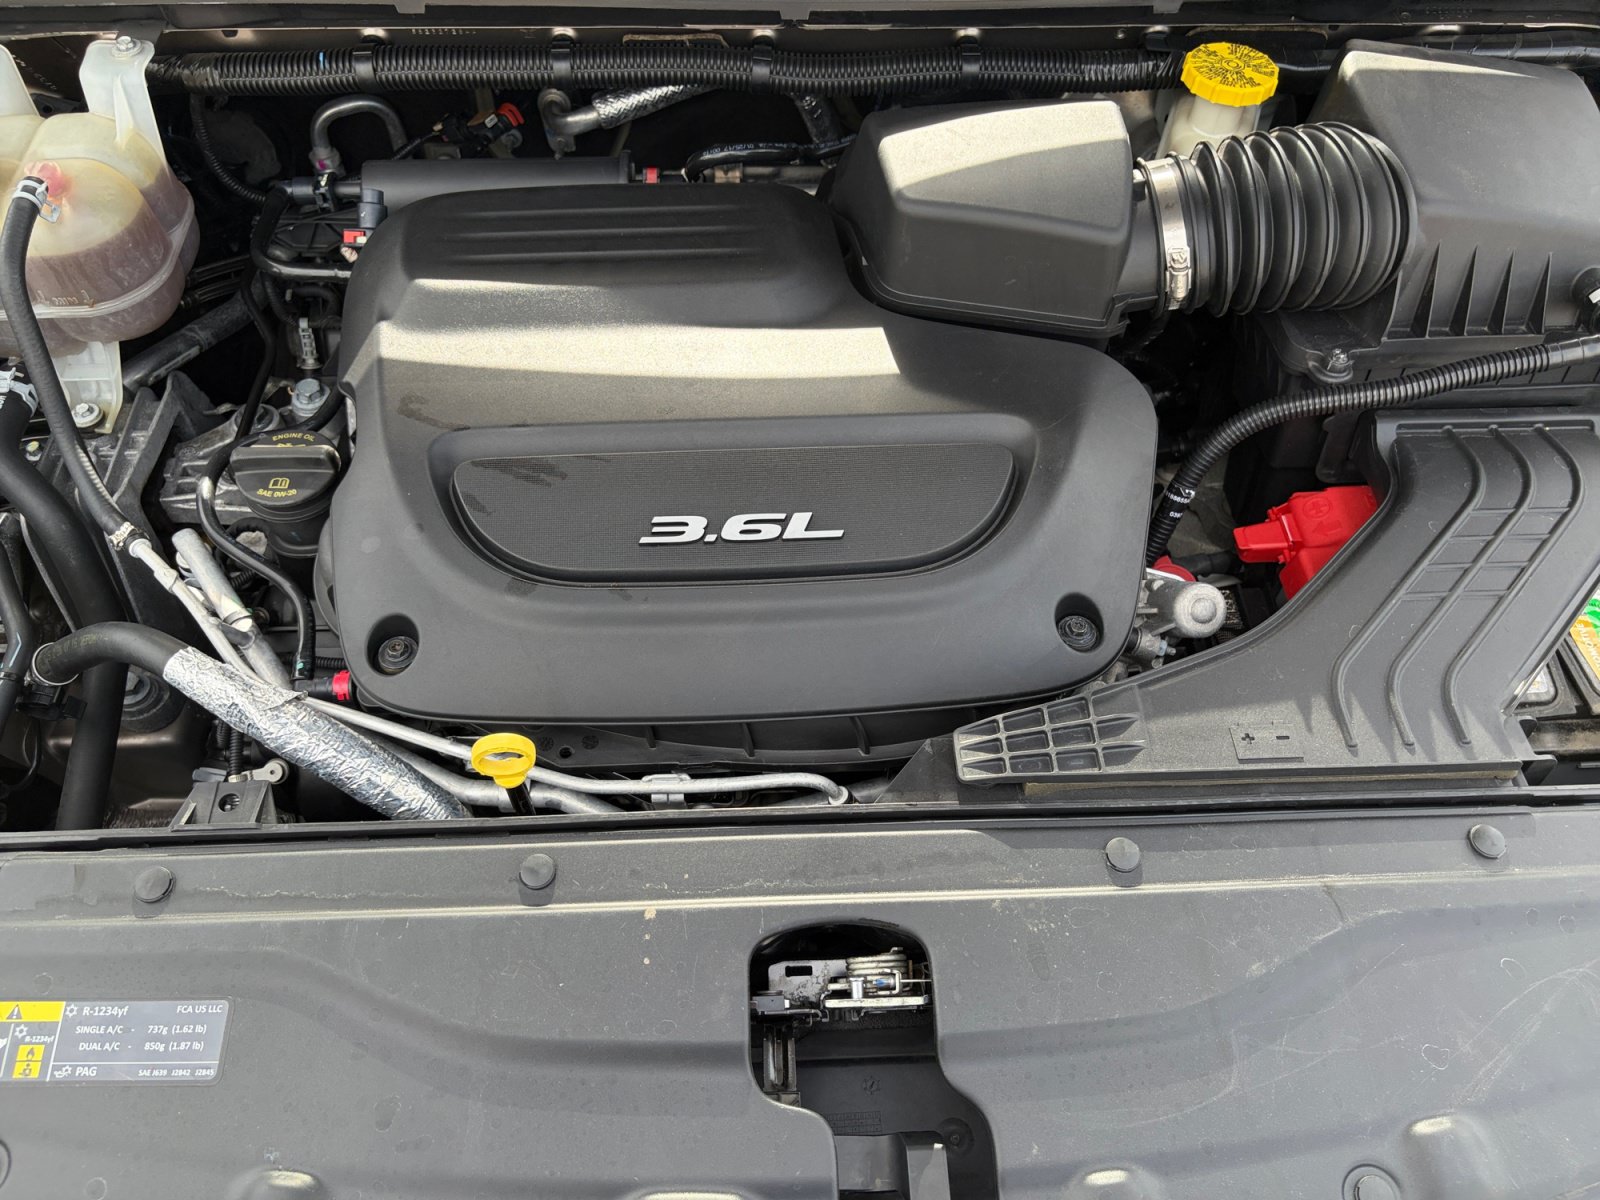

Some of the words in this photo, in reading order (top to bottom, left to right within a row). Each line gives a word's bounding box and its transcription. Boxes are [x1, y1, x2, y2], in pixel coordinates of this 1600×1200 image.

[272, 432, 303, 441] ENGINE
[303, 433, 316, 442] OIL
[256, 488, 273, 497] SAE
[273, 488, 298, 498] 0W-20
[638, 511, 845, 545] 3.6L
[82, 1005, 129, 1018] R-1234yf
[176, 1004, 193, 1014] FCA
[194, 1004, 207, 1013] US
[207, 1004, 223, 1013] LLC
[75, 1025, 106, 1034] SINGLE
[106, 1024, 124, 1036] A/C
[147, 1024, 169, 1036] 737g
[171, 1024, 194, 1036] (1.62
[194, 1023, 207, 1035] lb)
[25, 1035, 55, 1044] R-1234yf
[79, 1042, 102, 1051] DUAL
[102, 1041, 121, 1052] A/C
[143, 1041, 166, 1053] 850g
[168, 1041, 191, 1053] (1.87
[191, 1040, 204, 1052] lb)
[75, 1066, 98, 1077] PAG
[137, 1068, 151, 1077] SAE
[151, 1068, 168, 1077] J639
